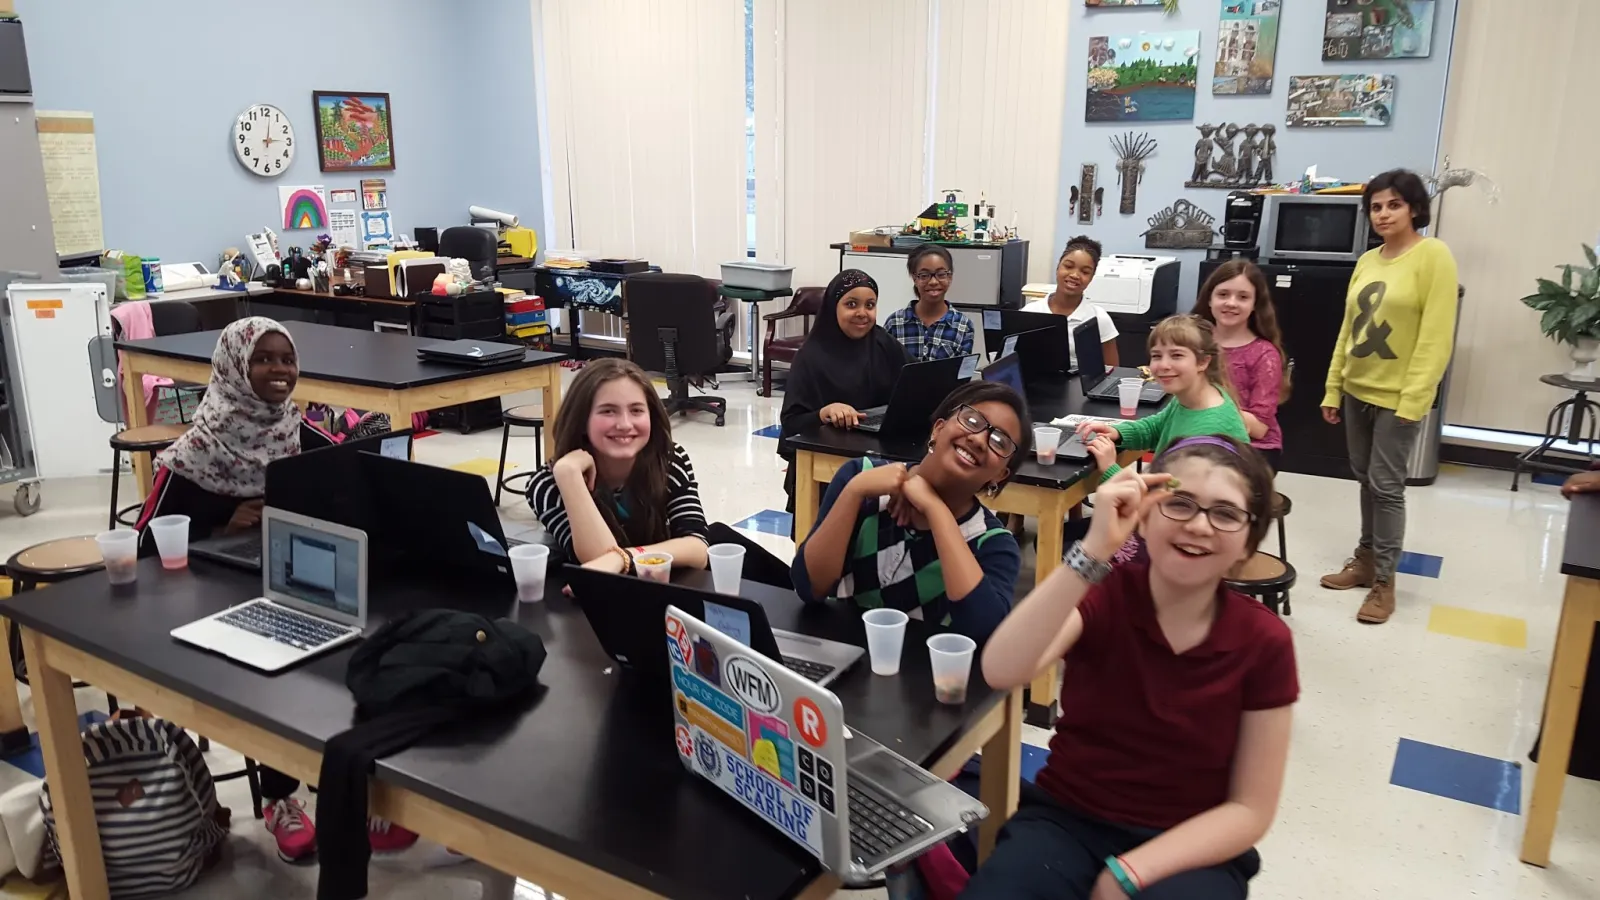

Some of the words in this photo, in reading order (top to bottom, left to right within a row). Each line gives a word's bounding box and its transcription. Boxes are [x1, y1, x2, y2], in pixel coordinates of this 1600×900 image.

[249, 111, 257, 121] 11
[260, 107, 271, 117] 12
[275, 113, 279, 122] 1
[240, 121, 252, 131] 10
[282, 125, 289, 134] 2
[239, 134, 245, 144] 9
[286, 137, 292, 147] 3
[244, 147, 250, 156] 8
[283, 149, 289, 158] 4
[253, 158, 259, 167] 7
[275, 159, 281, 168] 5
[264, 163, 270, 173] 6
[1147, 206, 1174, 228] OHIO
[732, 663, 773, 709] WFM
[677, 675, 699, 694] HOUR
[701, 688, 713, 701] OF
[715, 697, 738, 720] CODE
[801, 703, 820, 741] R
[726, 753, 786, 808] SCHOOL
[792, 798, 814, 826] OF
[735, 778, 807, 842] SCARING
